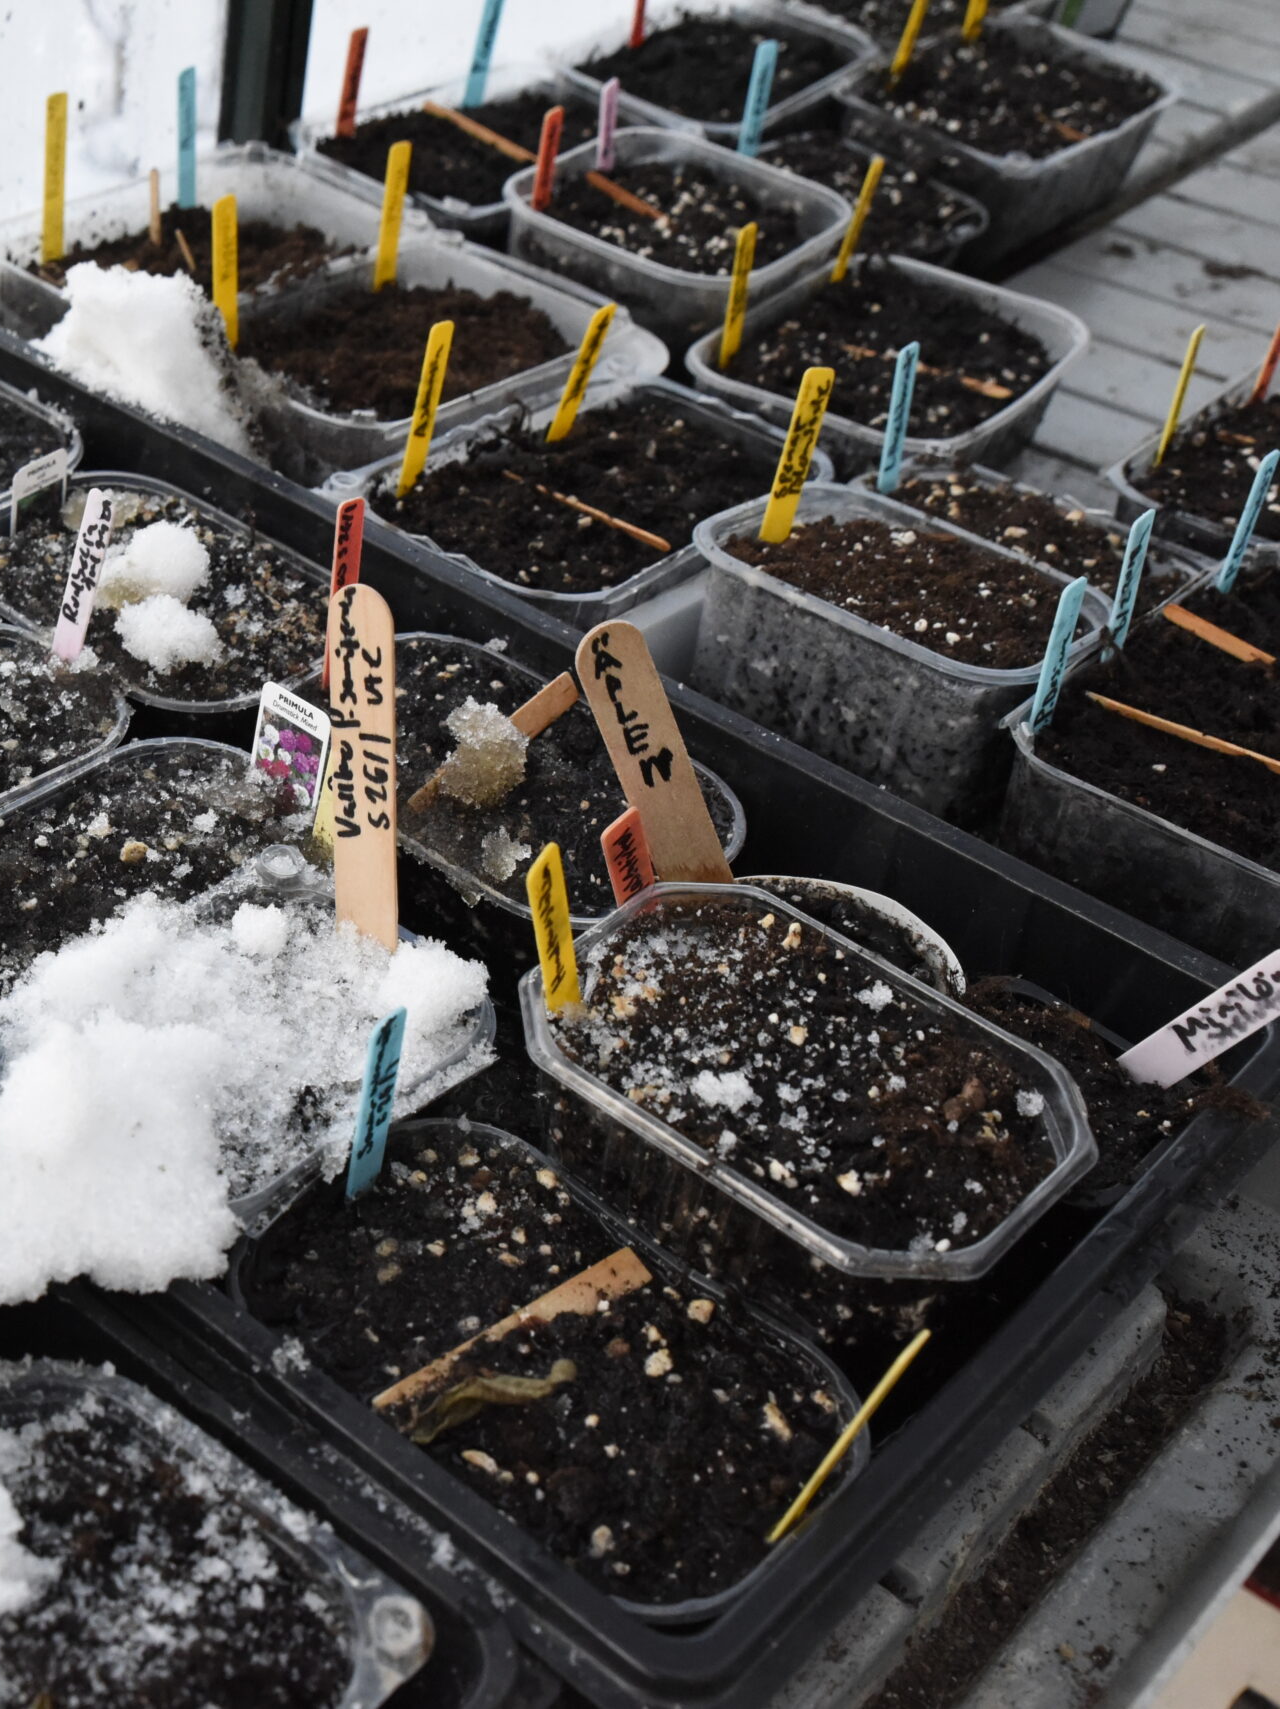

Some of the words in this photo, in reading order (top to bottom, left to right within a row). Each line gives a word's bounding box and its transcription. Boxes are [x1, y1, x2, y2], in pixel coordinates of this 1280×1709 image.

[272, 699, 300, 720] Drumstick
[300, 717, 318, 732] Mixed
[278, 693, 314, 721] PRIMULA
